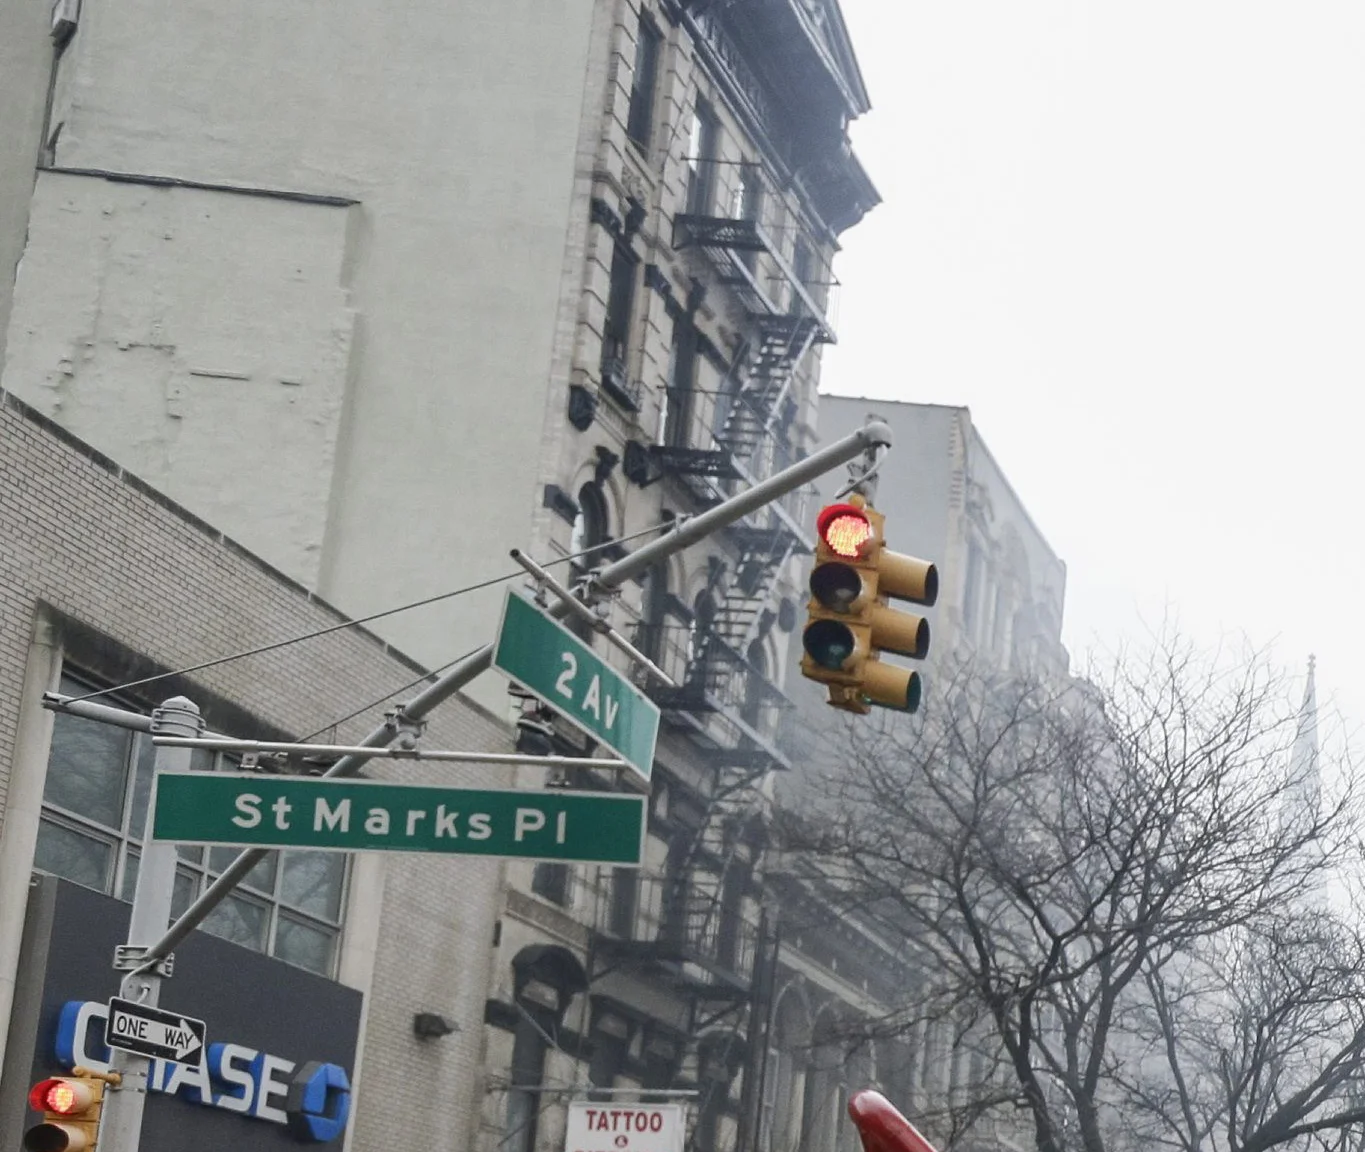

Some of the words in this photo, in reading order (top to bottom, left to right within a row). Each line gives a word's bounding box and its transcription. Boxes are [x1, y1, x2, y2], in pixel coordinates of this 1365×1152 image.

[555, 651, 579, 700] 2
[581, 680, 621, 731] Av
[231, 793, 293, 831] St
[313, 797, 493, 841] Marks
[514, 807, 567, 845] Pl
[115, 1014, 150, 1039] ONE
[163, 1027, 194, 1051] WAY
[585, 1109, 664, 1133] TATTOO
